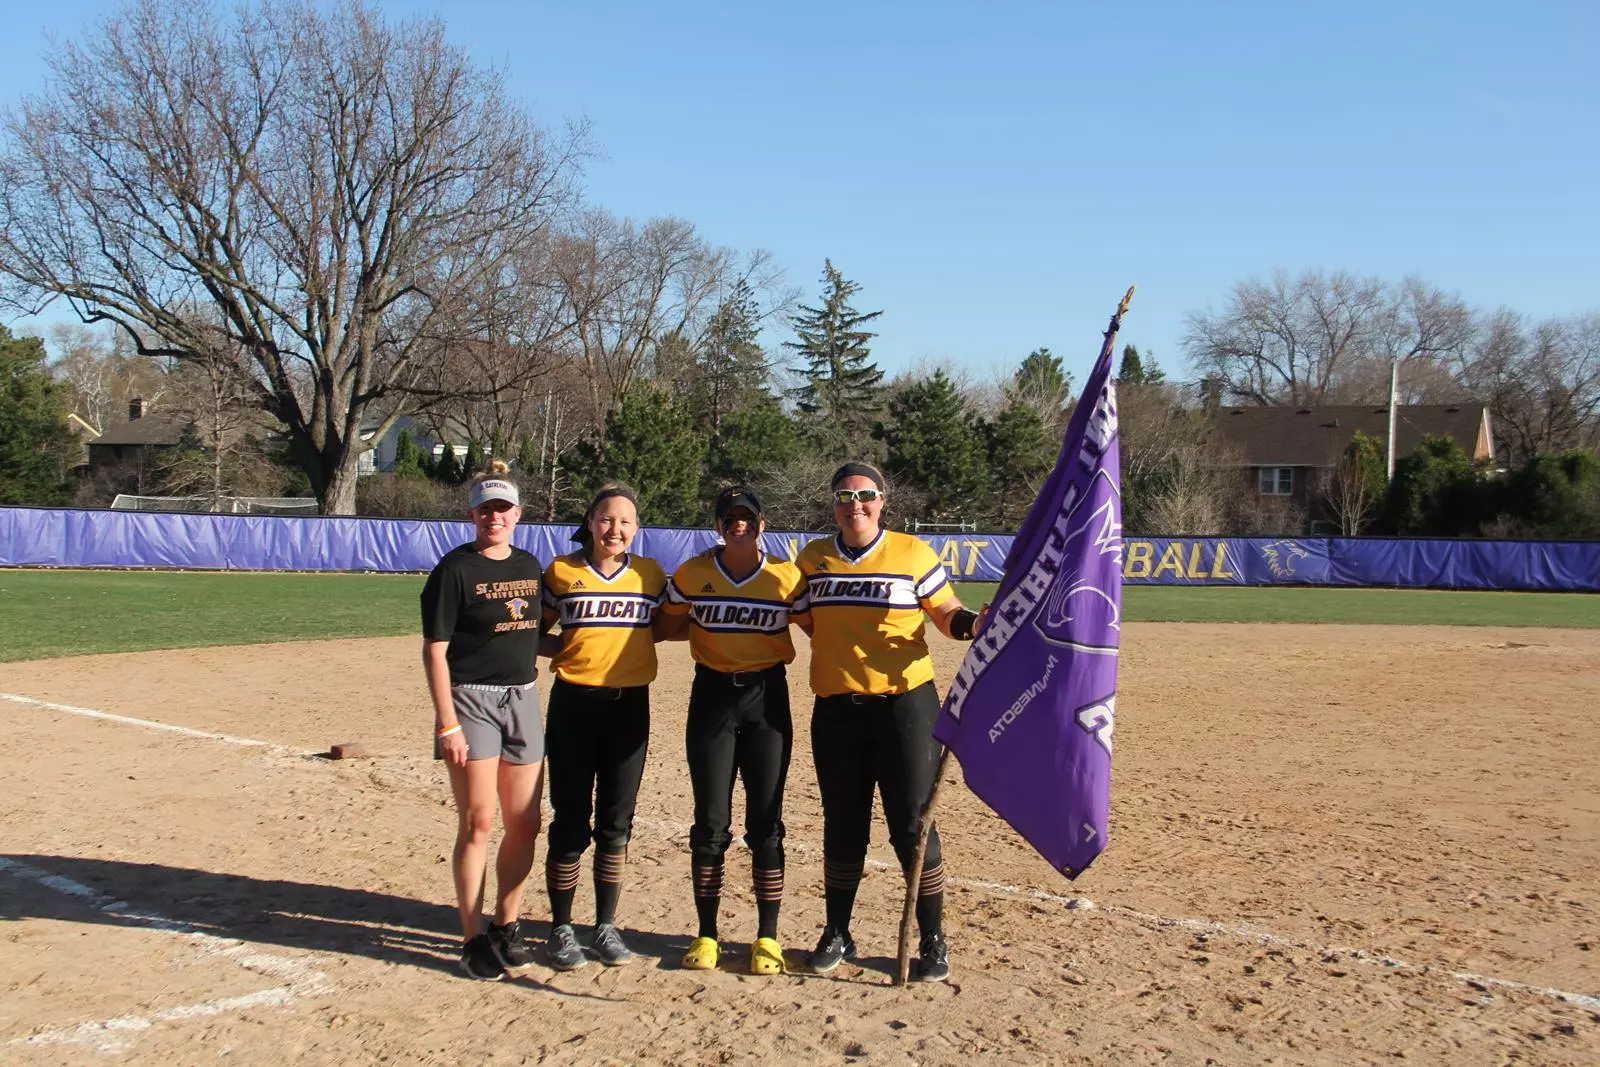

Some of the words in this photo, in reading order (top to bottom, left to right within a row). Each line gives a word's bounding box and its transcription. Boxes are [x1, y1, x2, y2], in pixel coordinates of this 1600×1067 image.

[1121, 542, 1233, 578] BALL
[475, 583, 492, 595] ST.
[492, 579, 538, 593] CATHERINE
[485, 589, 537, 600] UNIVERSITY
[810, 580, 894, 599] WILDCATS
[692, 604, 779, 627] WILDCATS
[494, 619, 538, 633] SOFTBALL
